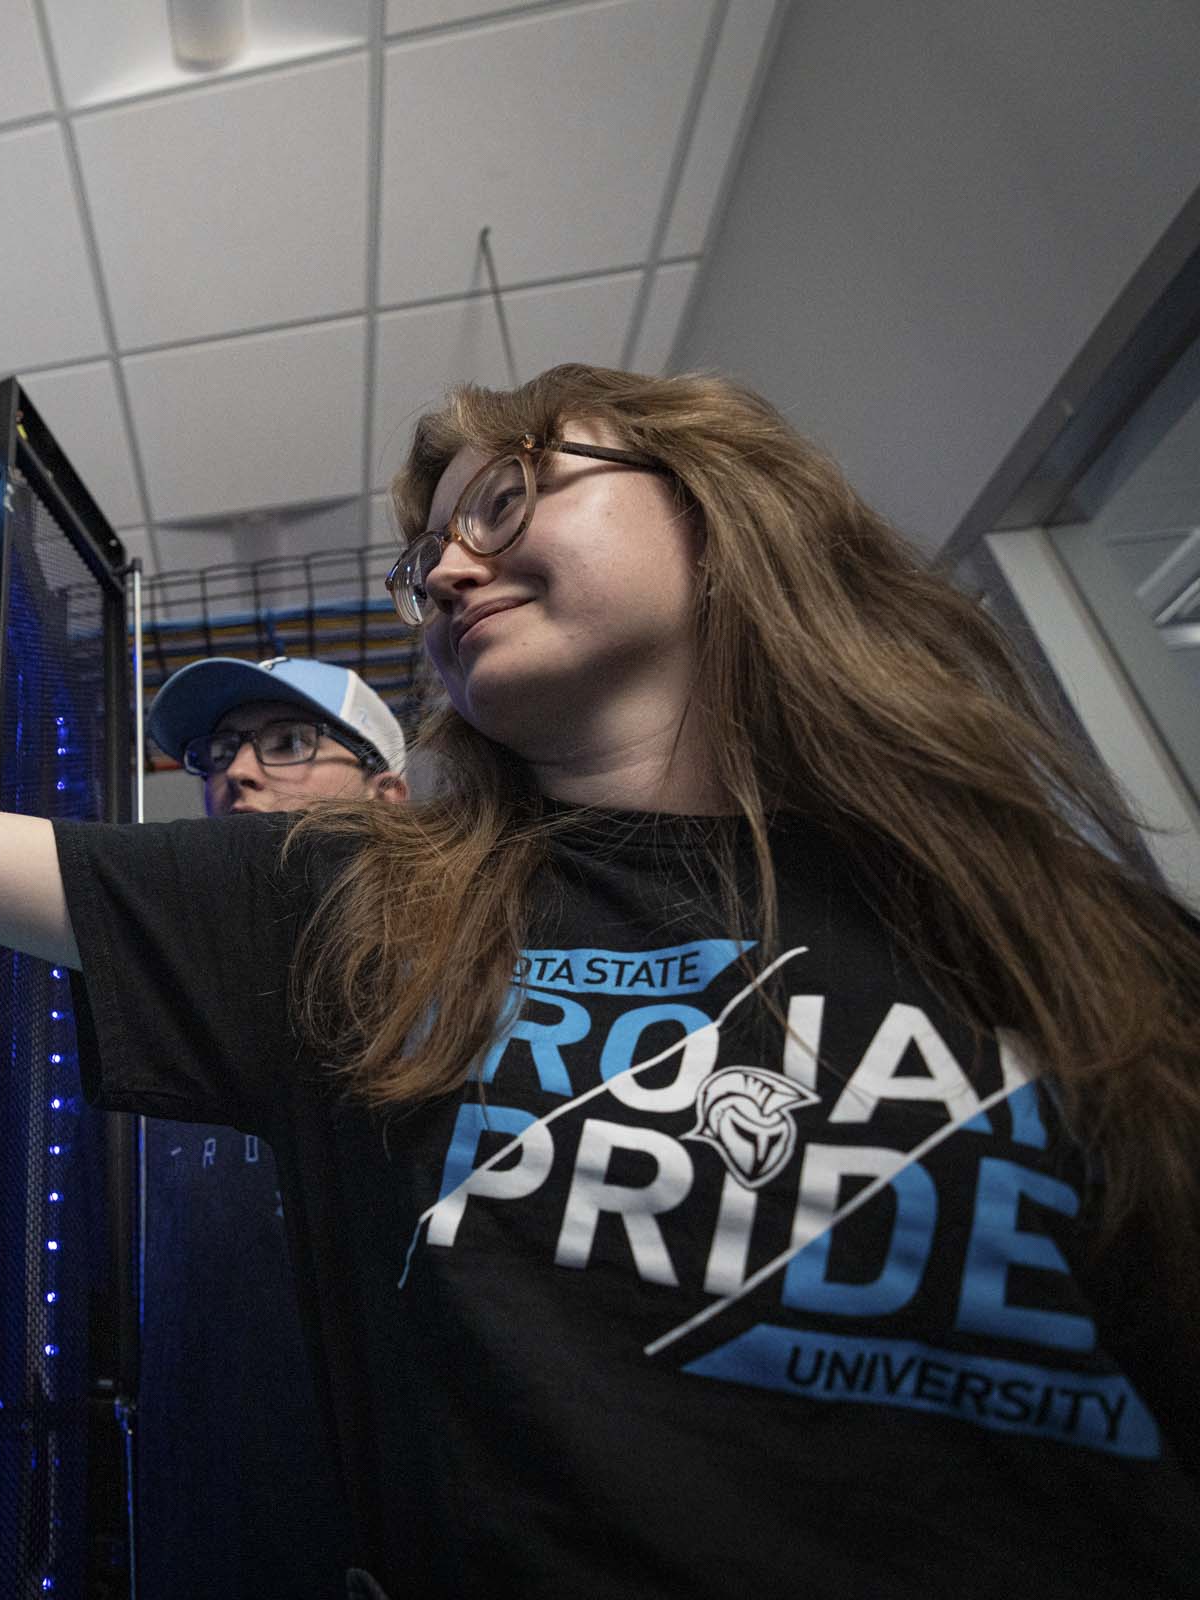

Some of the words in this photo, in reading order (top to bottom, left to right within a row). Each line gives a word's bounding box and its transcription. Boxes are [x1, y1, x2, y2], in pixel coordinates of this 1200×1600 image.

[583, 951, 701, 989] STATE
[426, 1102, 1097, 1353] PRIDE
[785, 1345, 1128, 1442] UNIVERSITY
